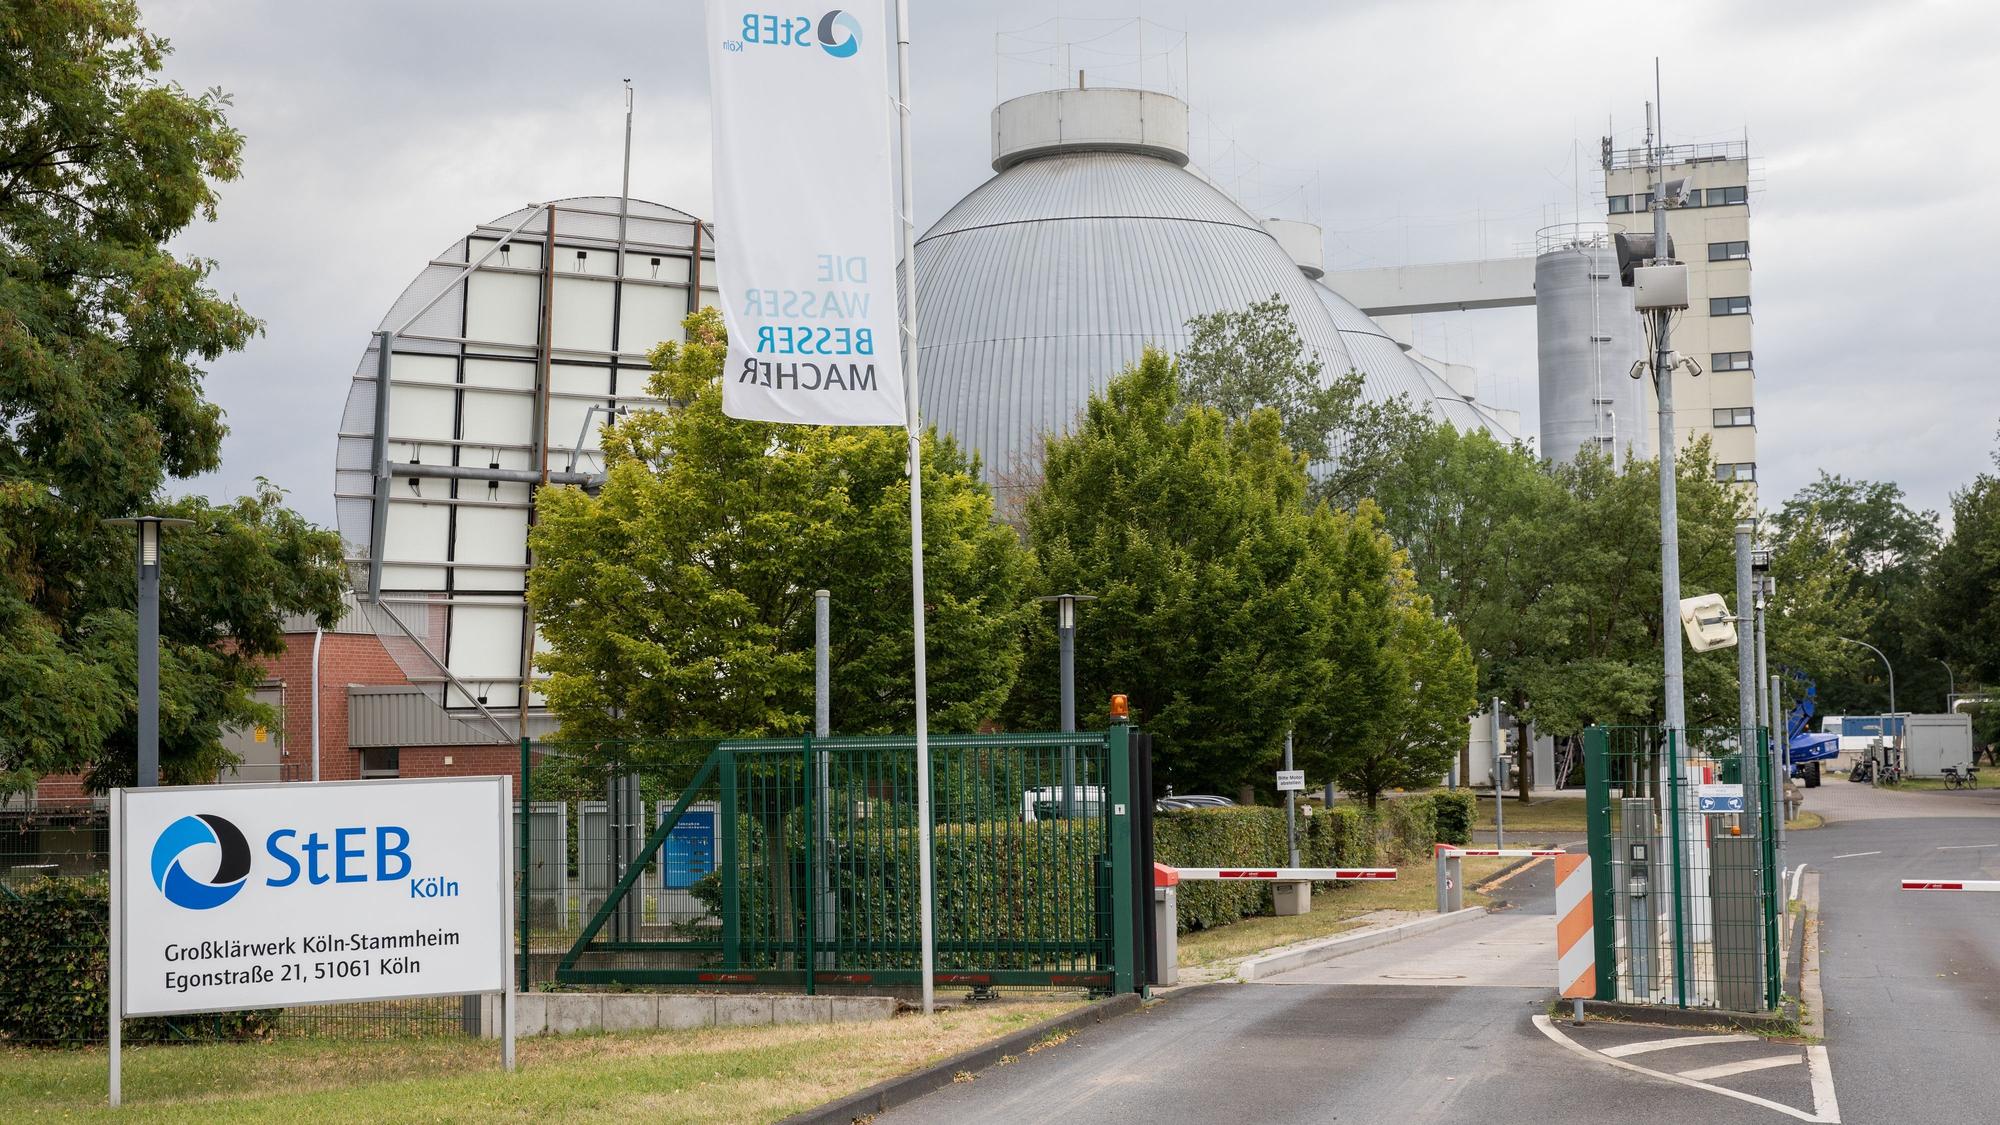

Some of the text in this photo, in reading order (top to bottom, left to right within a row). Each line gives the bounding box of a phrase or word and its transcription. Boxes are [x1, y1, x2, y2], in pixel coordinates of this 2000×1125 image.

[265, 826, 459, 899] StEB Köln
[164, 929, 460, 962] Großklärwerk Köln-Stammheim
[165, 956, 420, 993] Egonstraße 21, 51061 Köln
